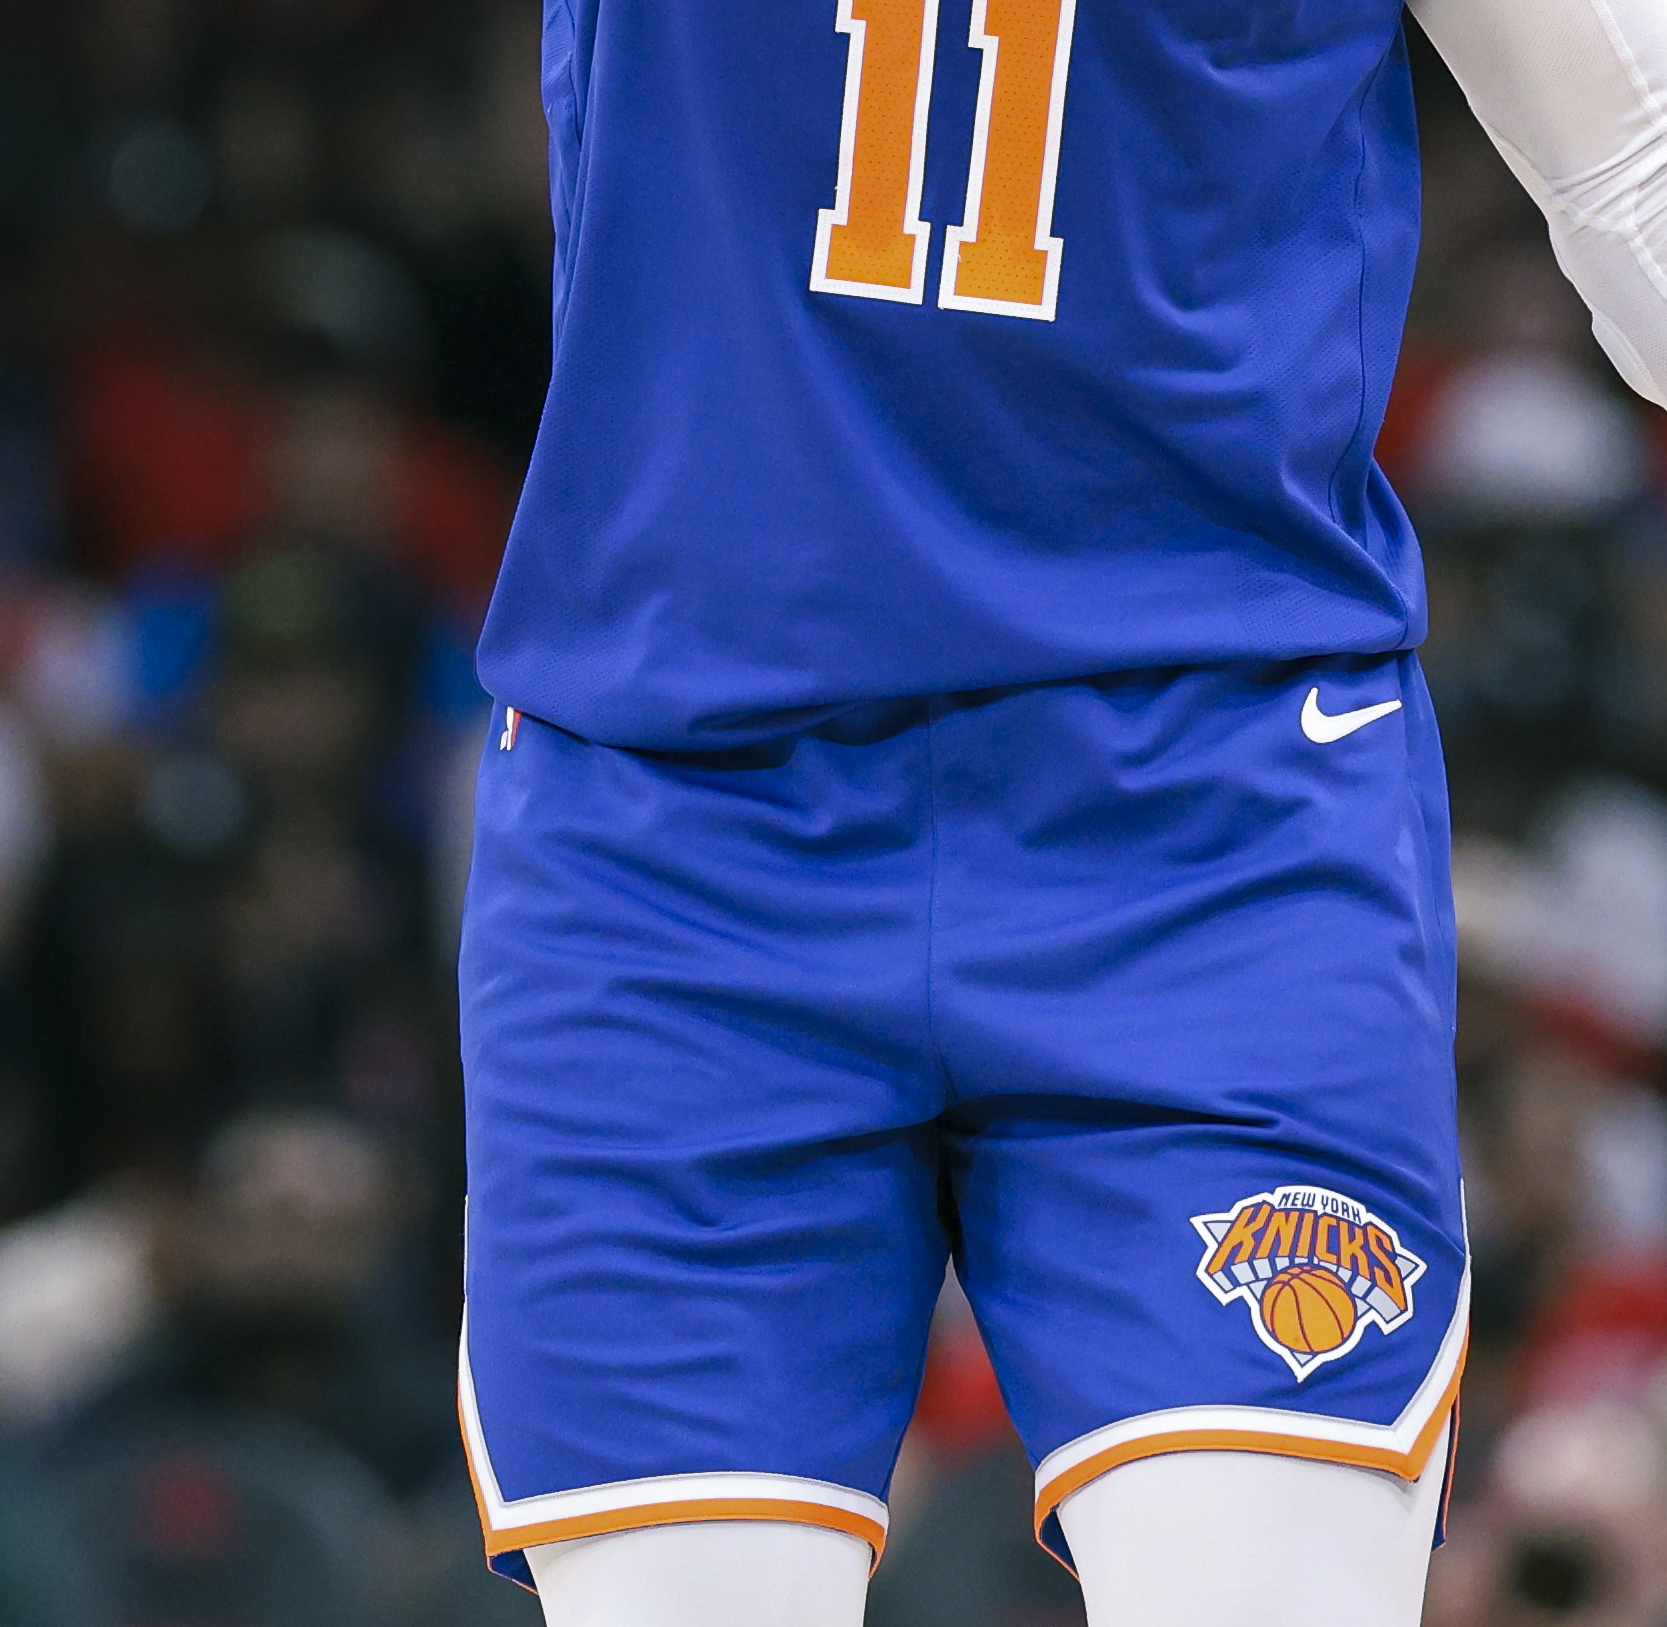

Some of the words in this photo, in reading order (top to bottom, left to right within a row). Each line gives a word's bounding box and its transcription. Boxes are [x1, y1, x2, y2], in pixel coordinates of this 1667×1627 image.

[1276, 1190, 1317, 1210] NEW
[1319, 1194, 1362, 1224] YORK
[1206, 1201, 1408, 1316] KNICKS
